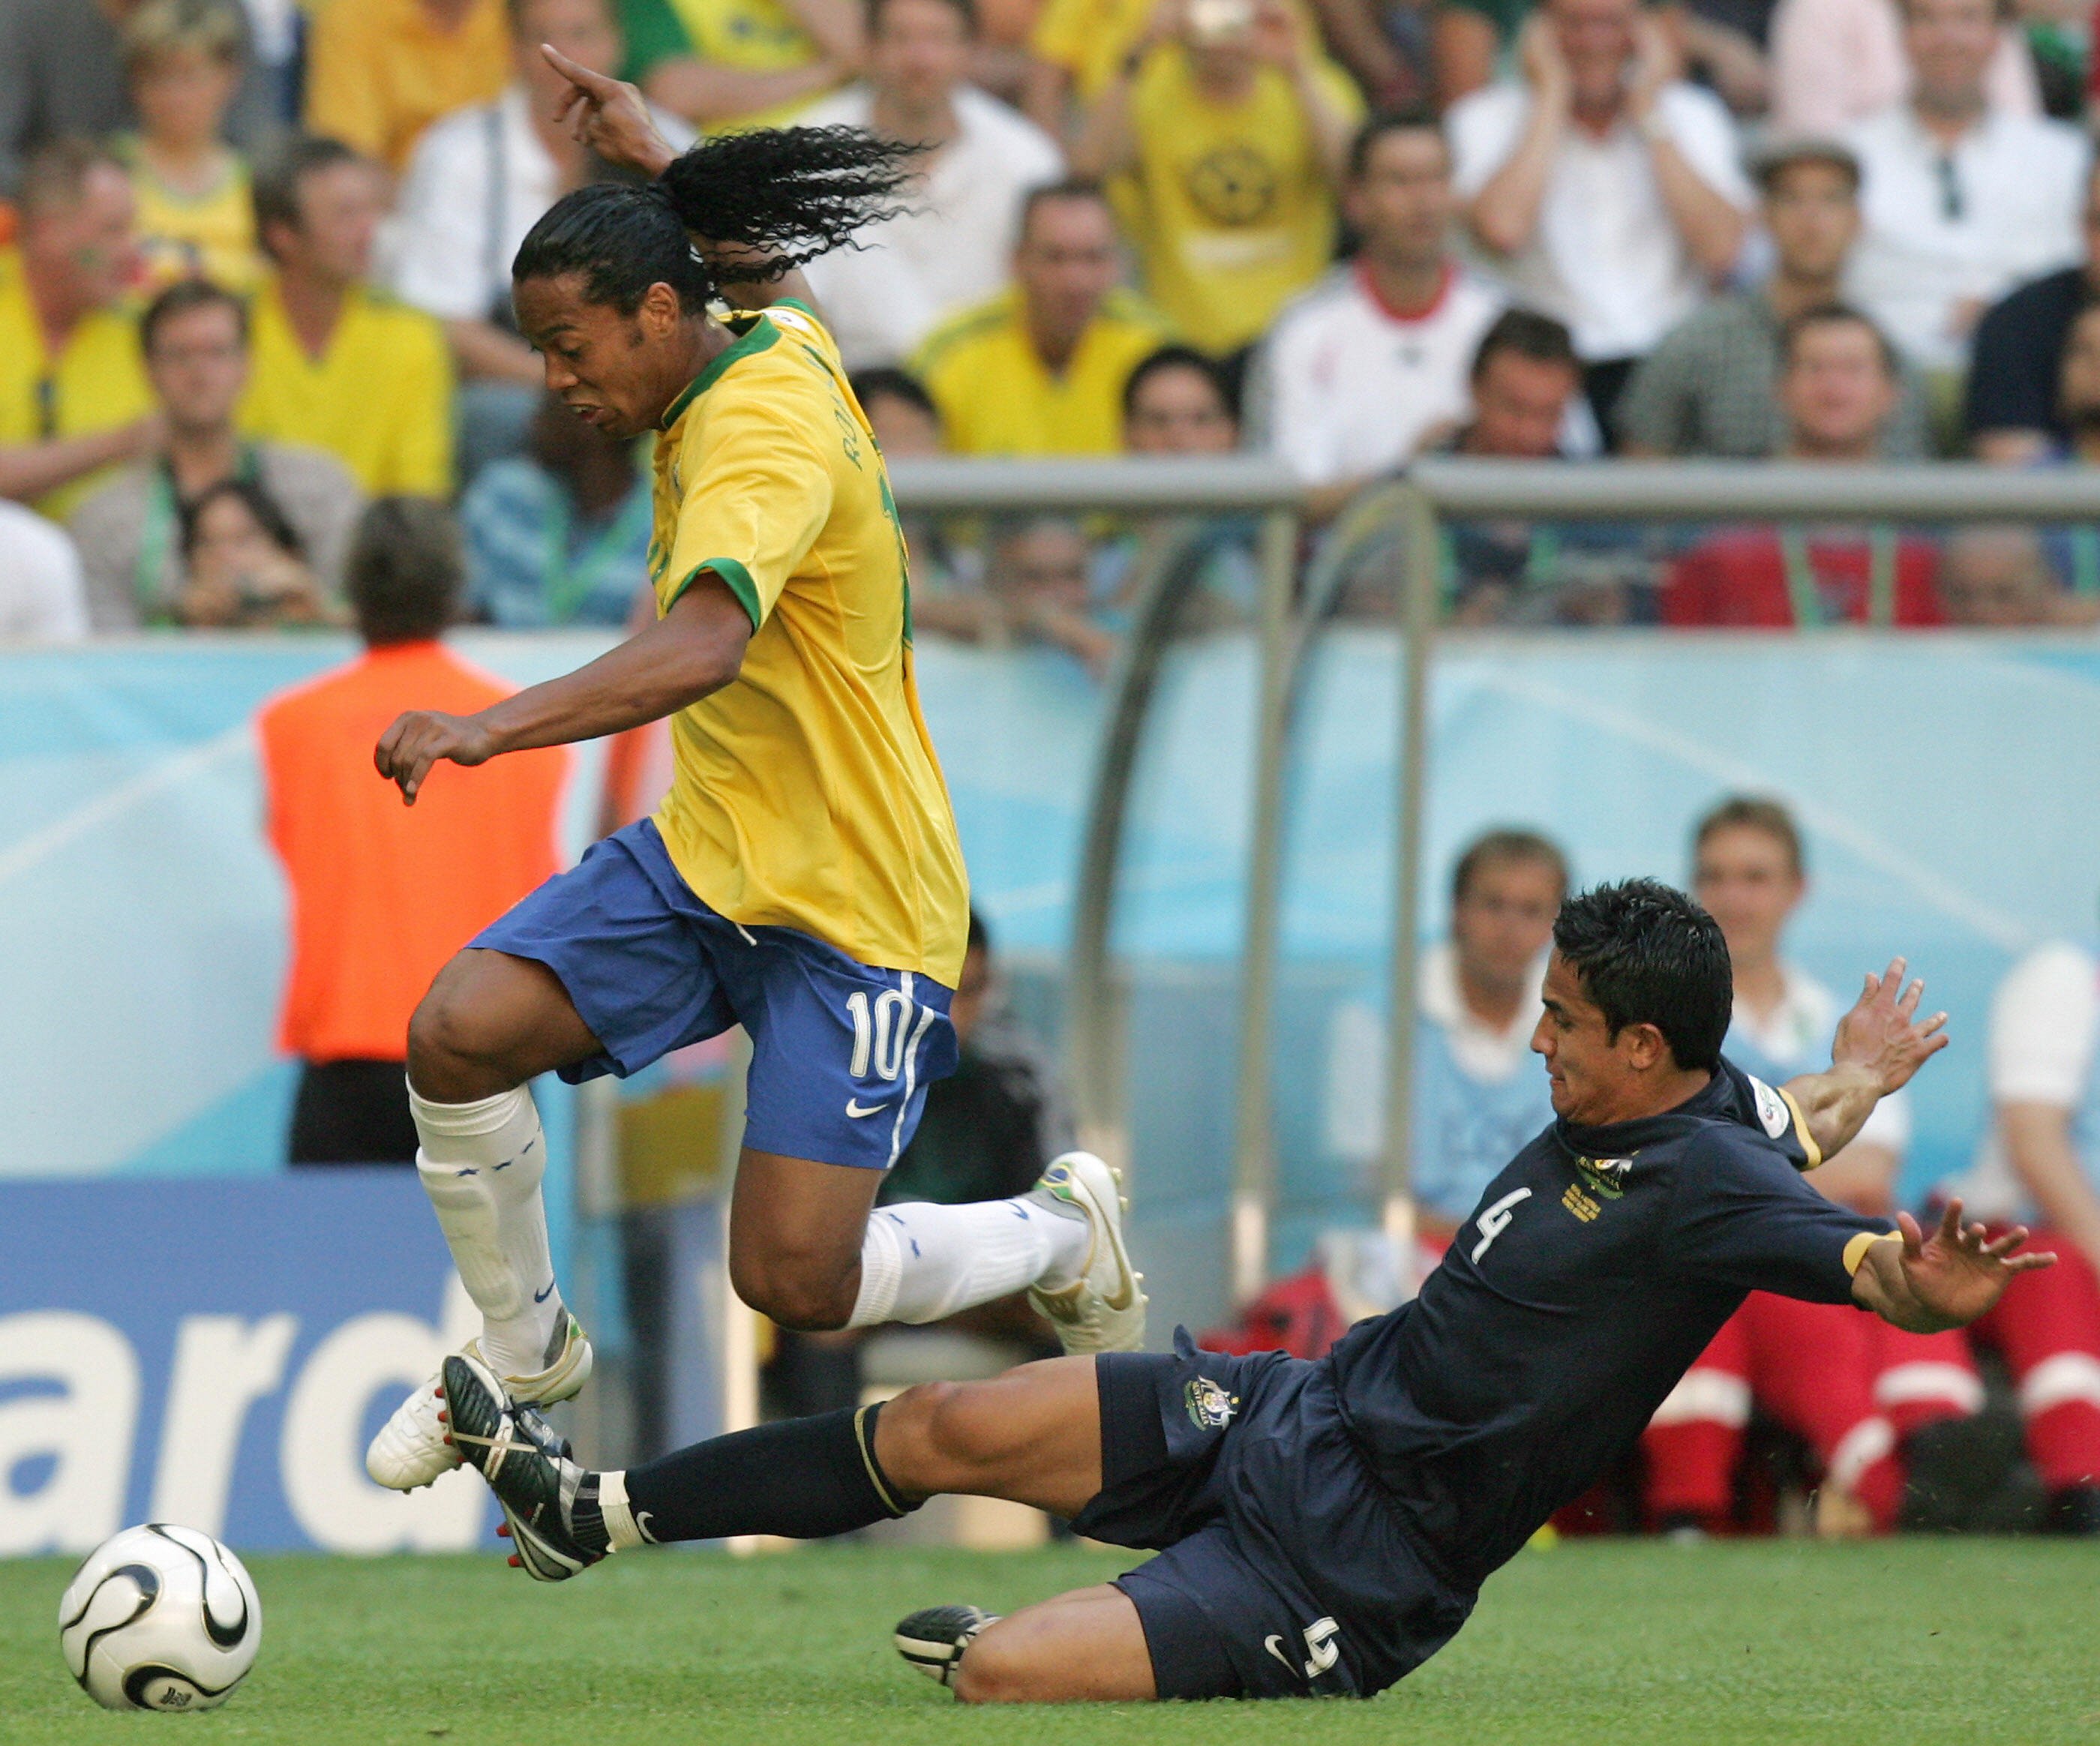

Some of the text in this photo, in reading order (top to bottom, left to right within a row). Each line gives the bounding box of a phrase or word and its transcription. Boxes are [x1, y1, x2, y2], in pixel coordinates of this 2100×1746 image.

[846, 988, 914, 1081] 10
[1471, 1186, 1532, 1265] 4
[0, 1266, 489, 1556] ard
